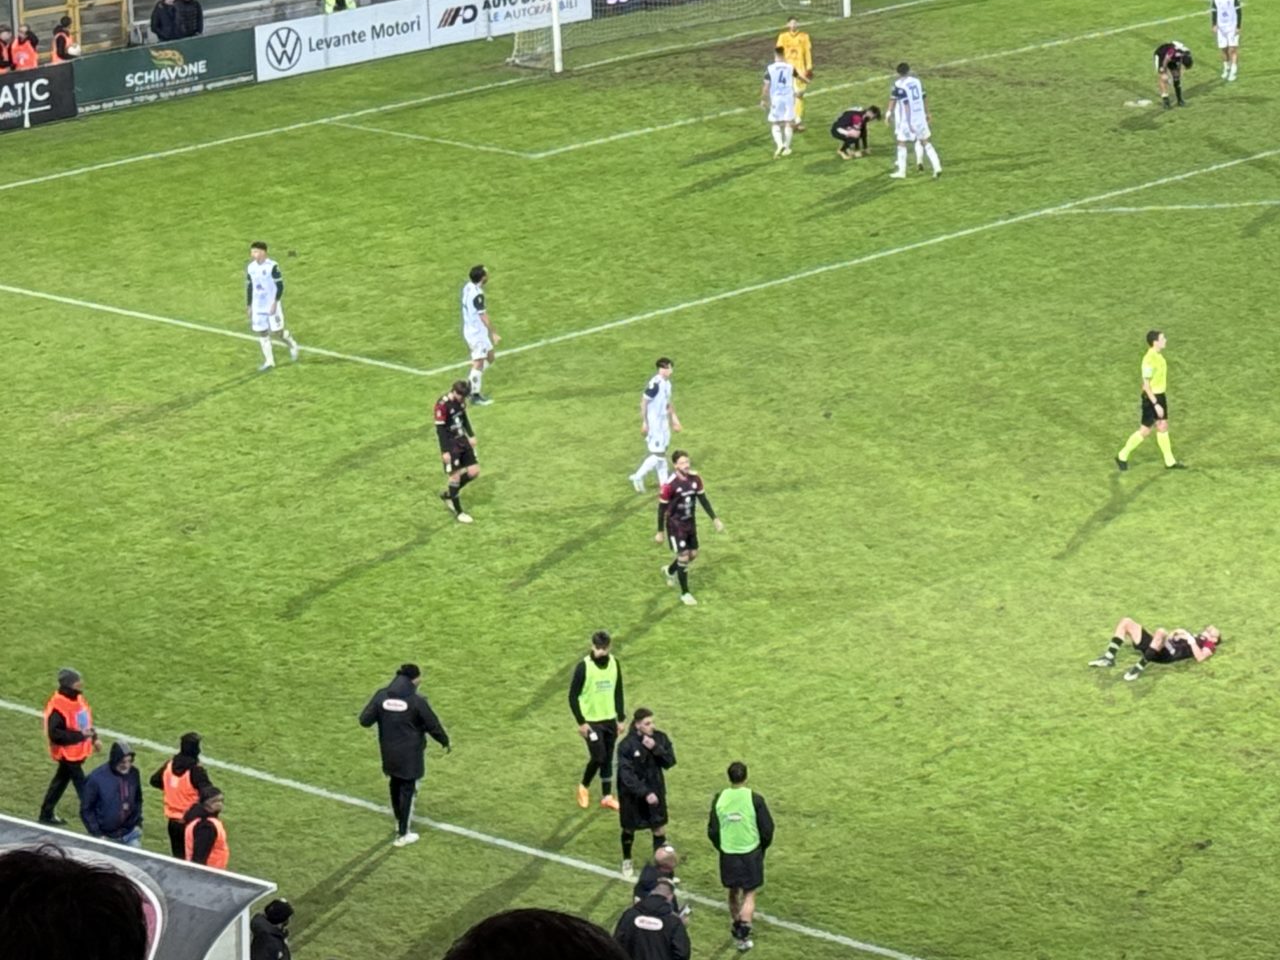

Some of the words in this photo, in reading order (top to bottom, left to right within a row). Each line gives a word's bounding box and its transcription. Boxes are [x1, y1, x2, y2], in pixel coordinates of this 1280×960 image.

[308, 29, 367, 53] Levante
[371, 15, 421, 40] Motori
[125, 60, 207, 87] SCHIAVONE
